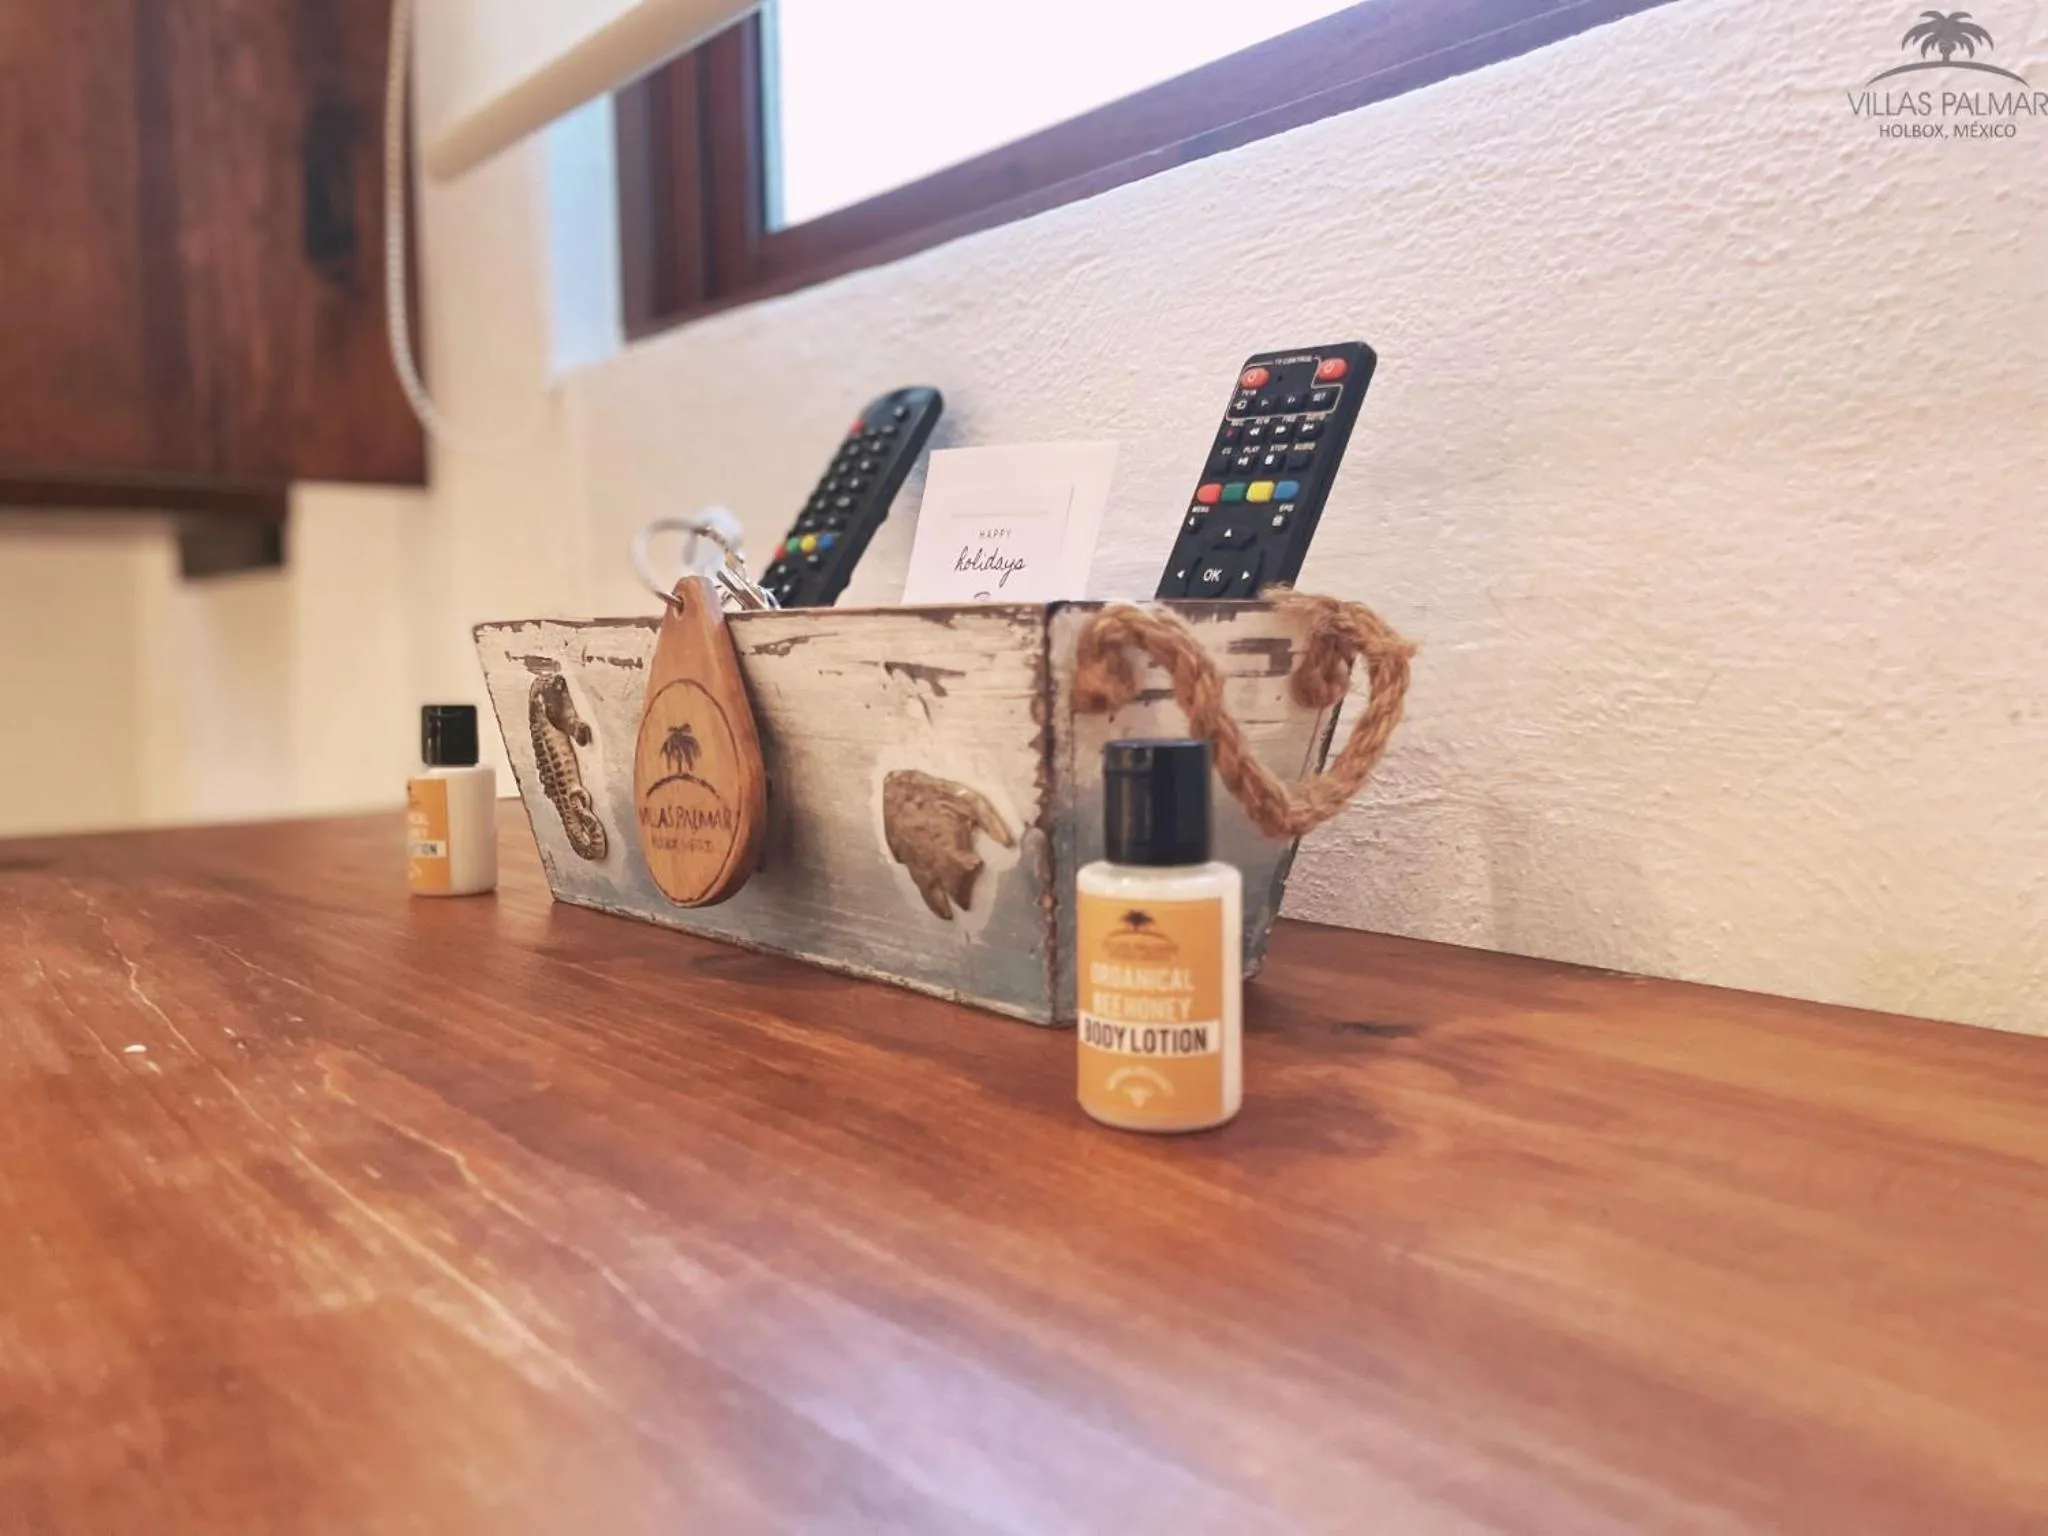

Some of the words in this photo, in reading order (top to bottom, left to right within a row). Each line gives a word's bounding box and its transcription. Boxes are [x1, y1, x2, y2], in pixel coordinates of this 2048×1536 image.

[979, 528, 1013, 539] HAPPY
[954, 545, 1027, 588] holidays
[1203, 568, 1223, 582] OK
[1090, 961, 1196, 992] ORGANICAL
[1085, 1017, 1127, 1052] BODY
[1130, 1026, 1208, 1055] LOTION
